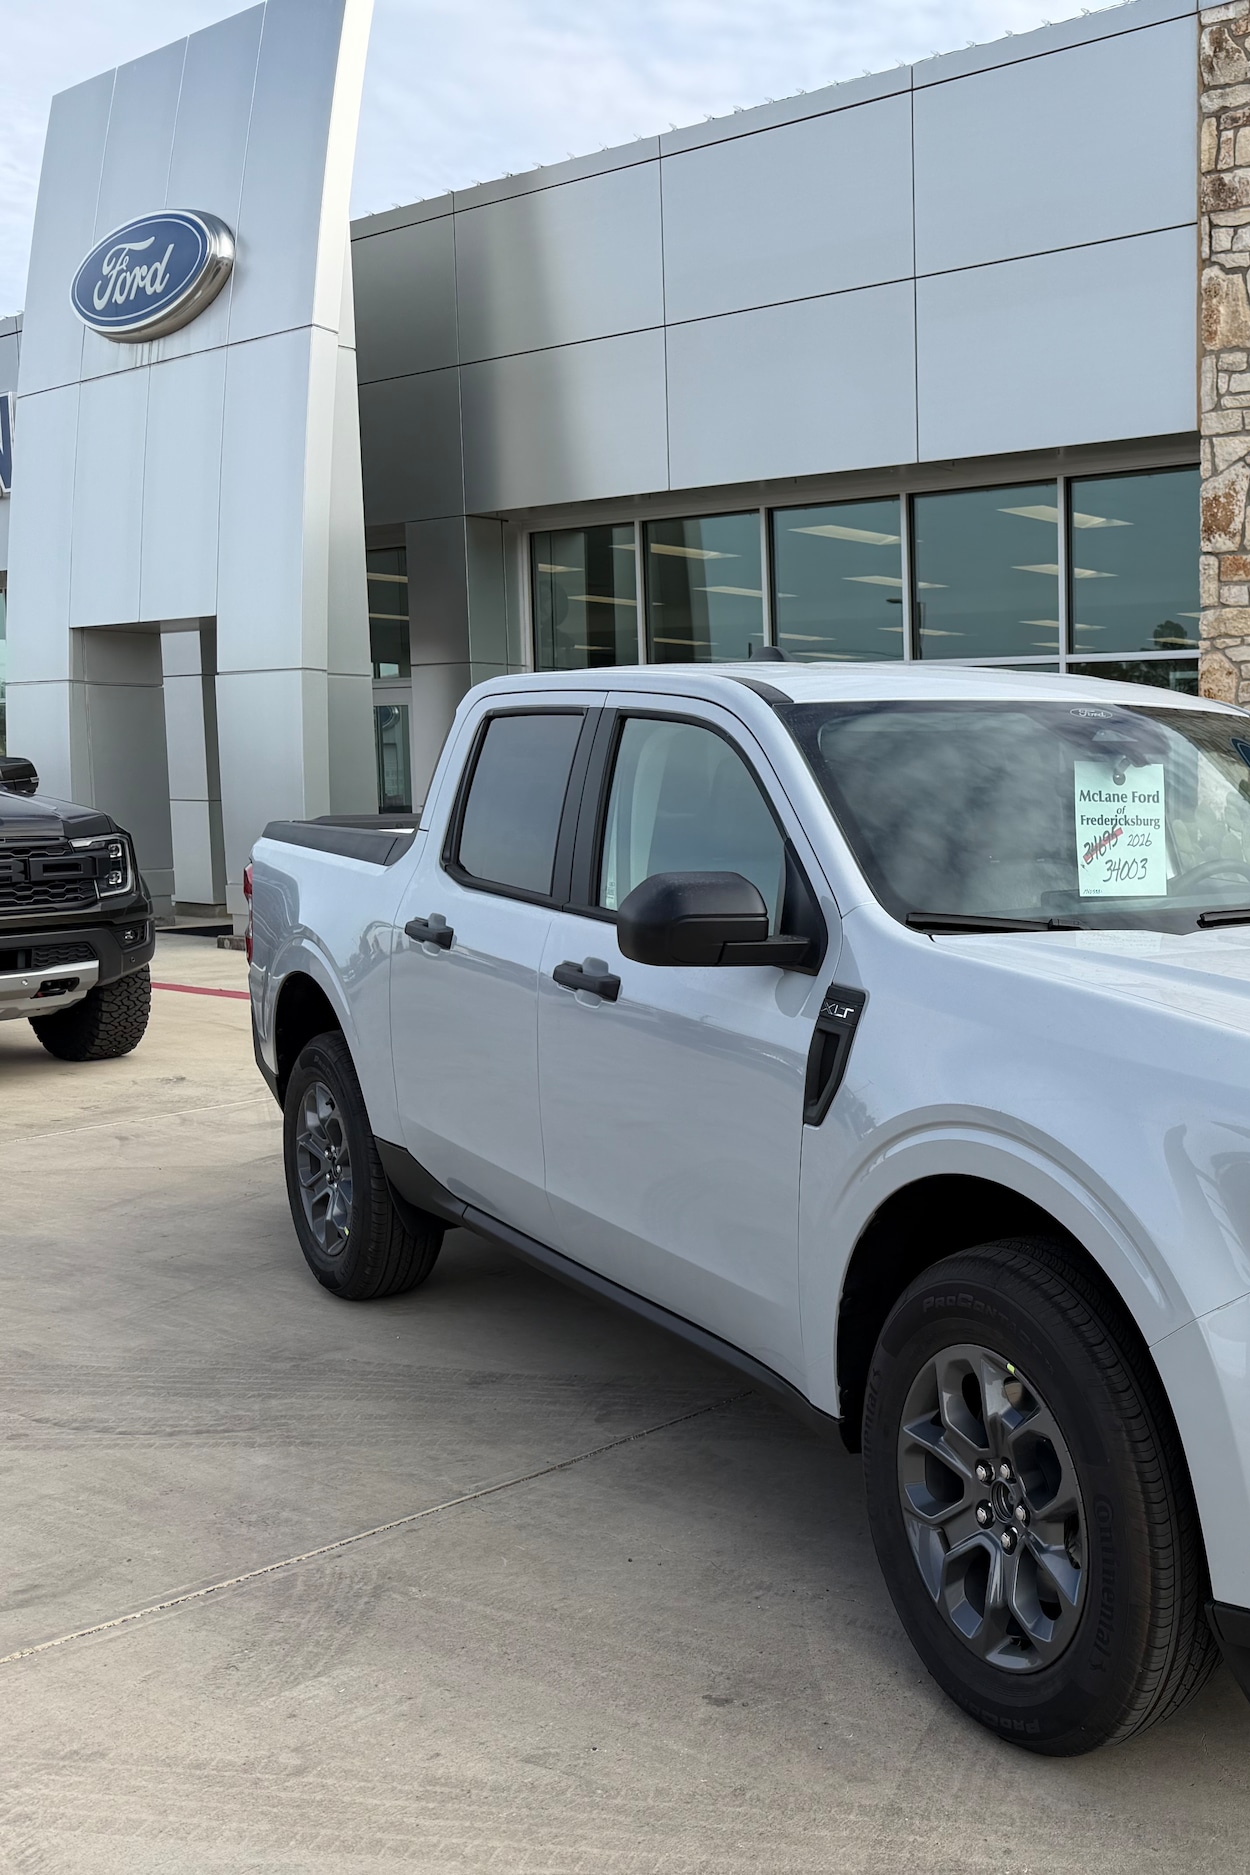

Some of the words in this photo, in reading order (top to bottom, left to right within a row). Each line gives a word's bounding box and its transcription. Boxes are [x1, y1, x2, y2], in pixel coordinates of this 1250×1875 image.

[93, 236, 175, 311] Ford
[1079, 790, 1128, 803] McLane
[1131, 791, 1160, 803] Ford
[1116, 806, 1126, 815] of
[1080, 815, 1160, 829] Fredericksburg
[1127, 833, 1152, 847] 2026
[1102, 858, 1148, 882] 34003
[820, 1001, 855, 1019] XLT
